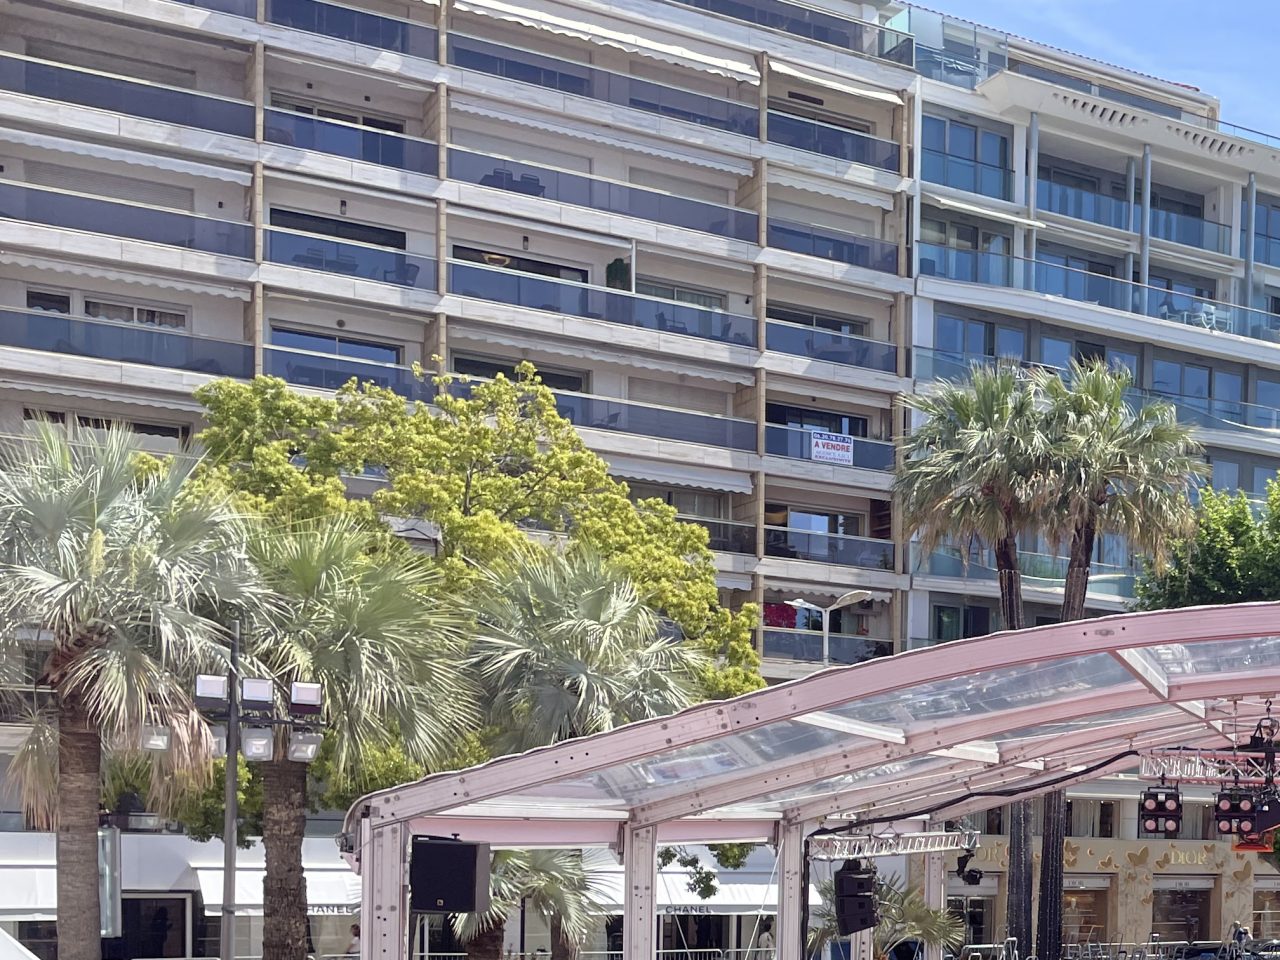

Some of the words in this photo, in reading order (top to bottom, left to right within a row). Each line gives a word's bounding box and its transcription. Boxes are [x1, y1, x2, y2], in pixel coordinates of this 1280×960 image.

[822, 442, 851, 452] VENDRE
[1170, 850, 1207, 865] DIOR
[306, 905, 353, 914] HANEL
[665, 905, 712, 914] CHANEL
